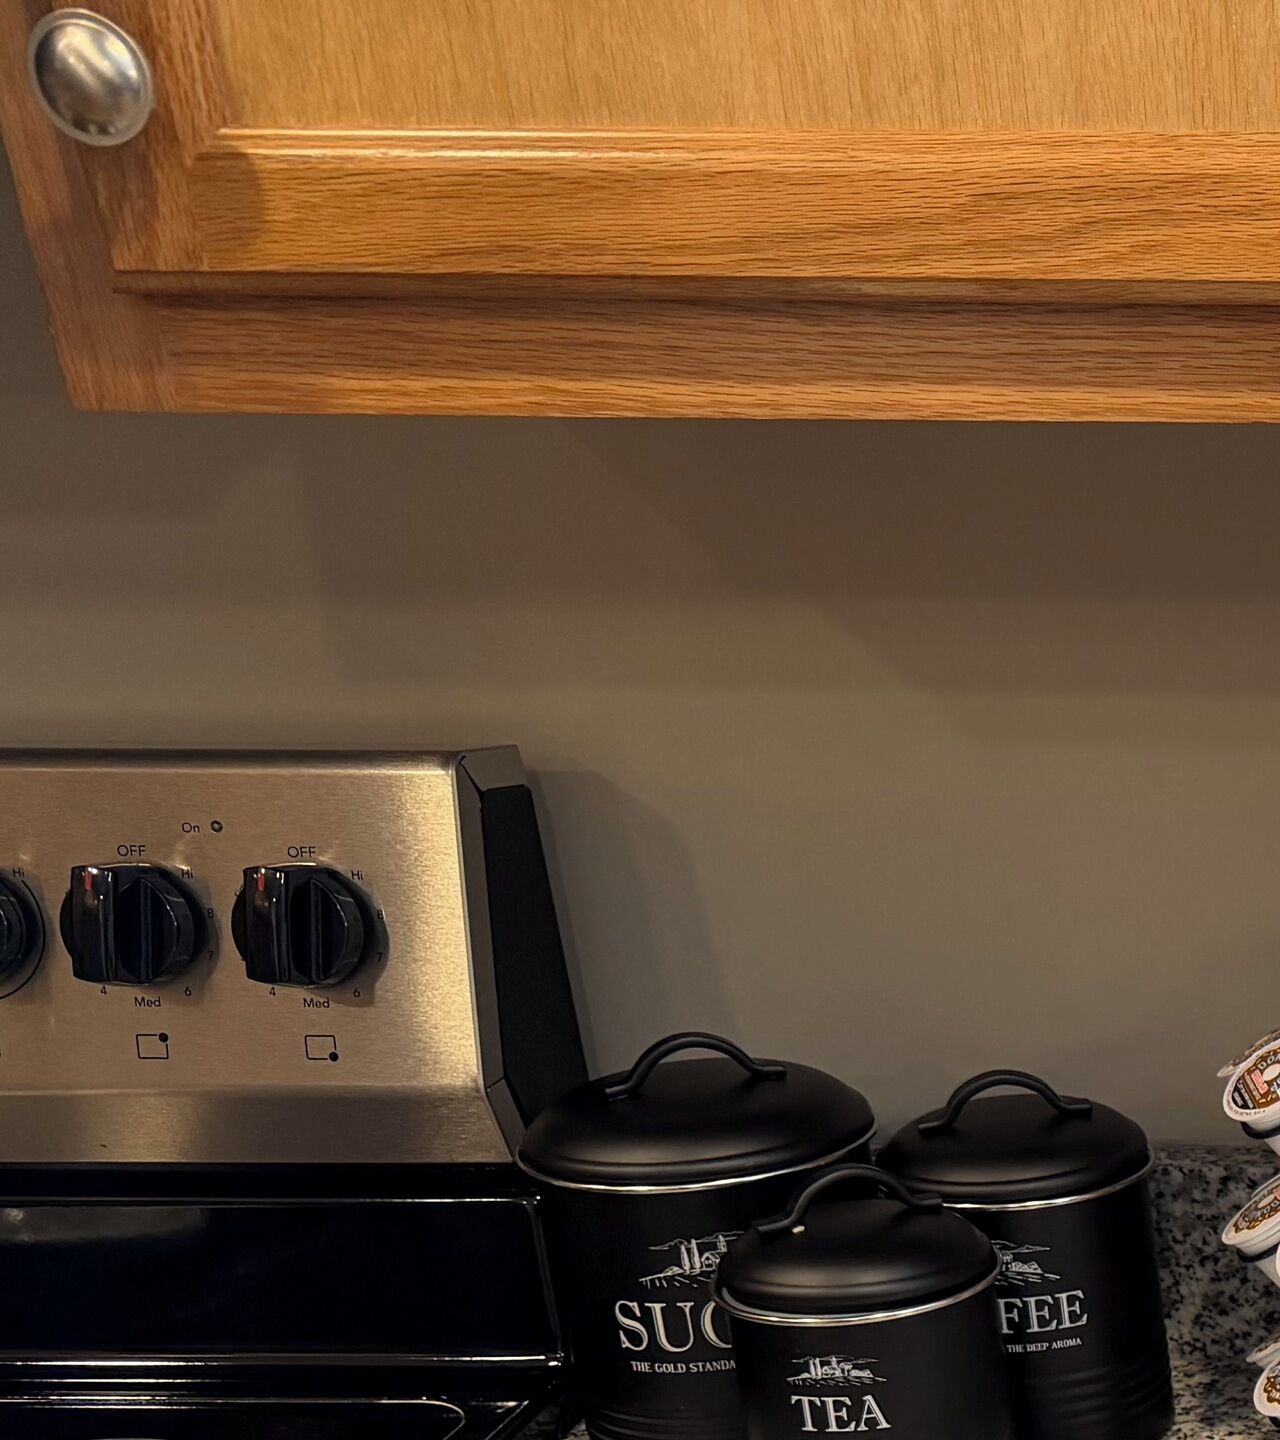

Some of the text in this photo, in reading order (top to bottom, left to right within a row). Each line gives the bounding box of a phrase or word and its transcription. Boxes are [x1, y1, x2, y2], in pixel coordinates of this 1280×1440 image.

[181, 822, 200, 833] On
[117, 845, 146, 857] OFF
[287, 846, 316, 858] OFF
[12, 868, 25, 878] Hi
[181, 869, 194, 879] Hi
[351, 870, 364, 880] Hi
[207, 908, 214, 919] 8
[376, 909, 384, 920] 8
[100, 986, 107, 995] 4
[184, 986, 192, 996] 6
[269, 987, 276, 996] 4
[353, 988, 360, 997] 6
[134, 997, 161, 1007] Med
[303, 998, 330, 1008] Med
[1006, 1344, 1025, 1353] THE
[1052, 1337, 1082, 1349] AROMA
[630, 1361, 653, 1373] THE
[655, 1362, 686, 1373] GOLD
[791, 1394, 892, 1432] TEA
